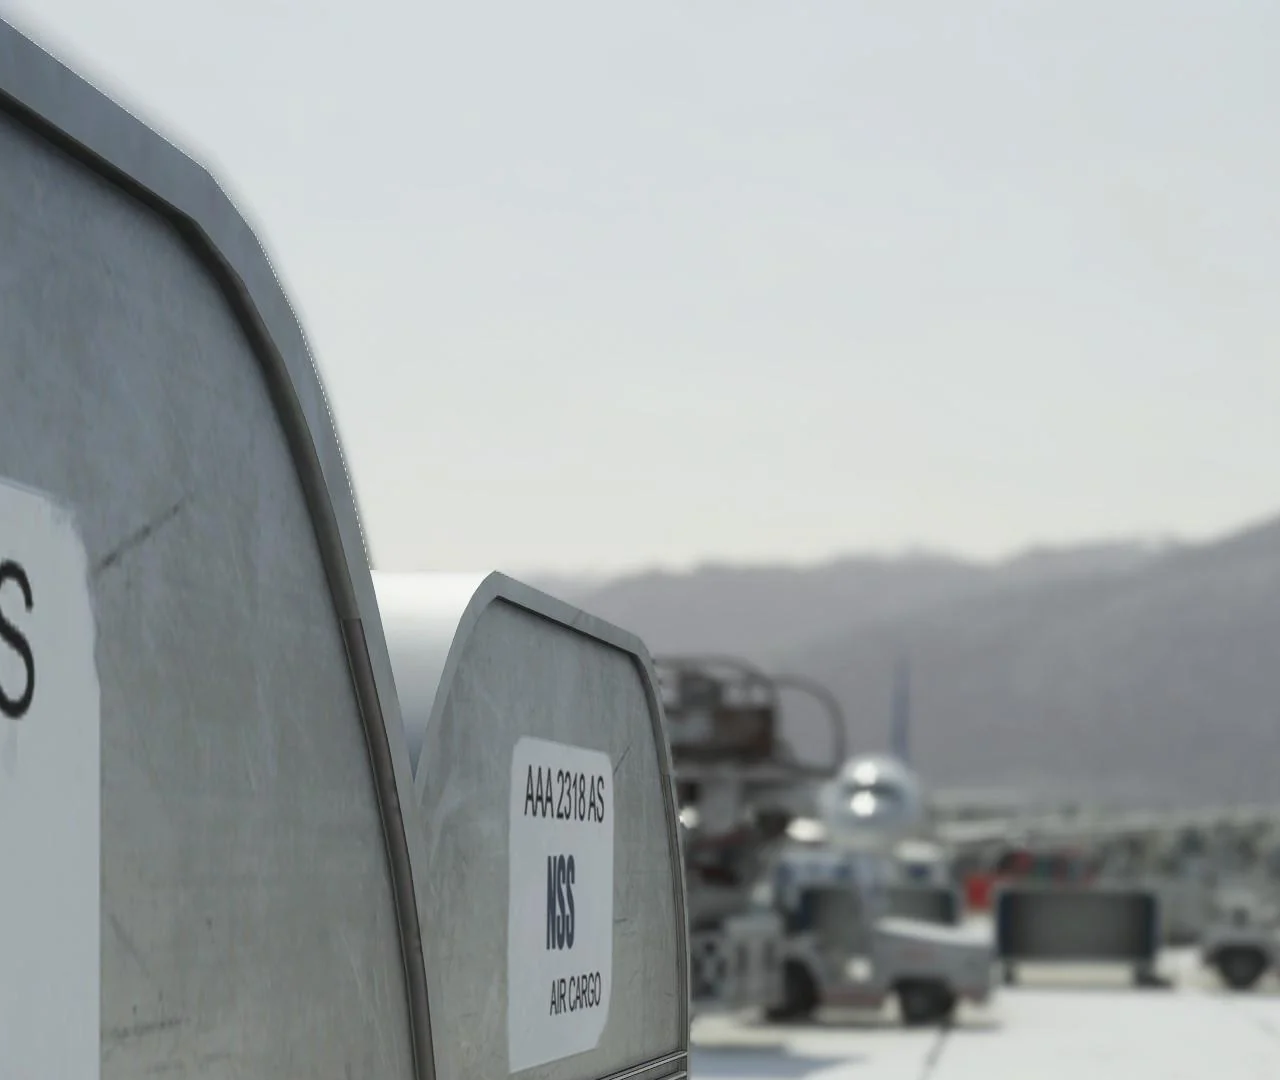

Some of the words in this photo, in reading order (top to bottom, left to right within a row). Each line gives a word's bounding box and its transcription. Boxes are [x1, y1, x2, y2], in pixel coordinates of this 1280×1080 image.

[524, 764, 554, 819] AAA
[556, 769, 586, 822] 2318
[588, 774, 605, 824] AS
[546, 854, 575, 950] NSS
[550, 978, 567, 1016] AIR
[569, 971, 601, 1013] CARGO
